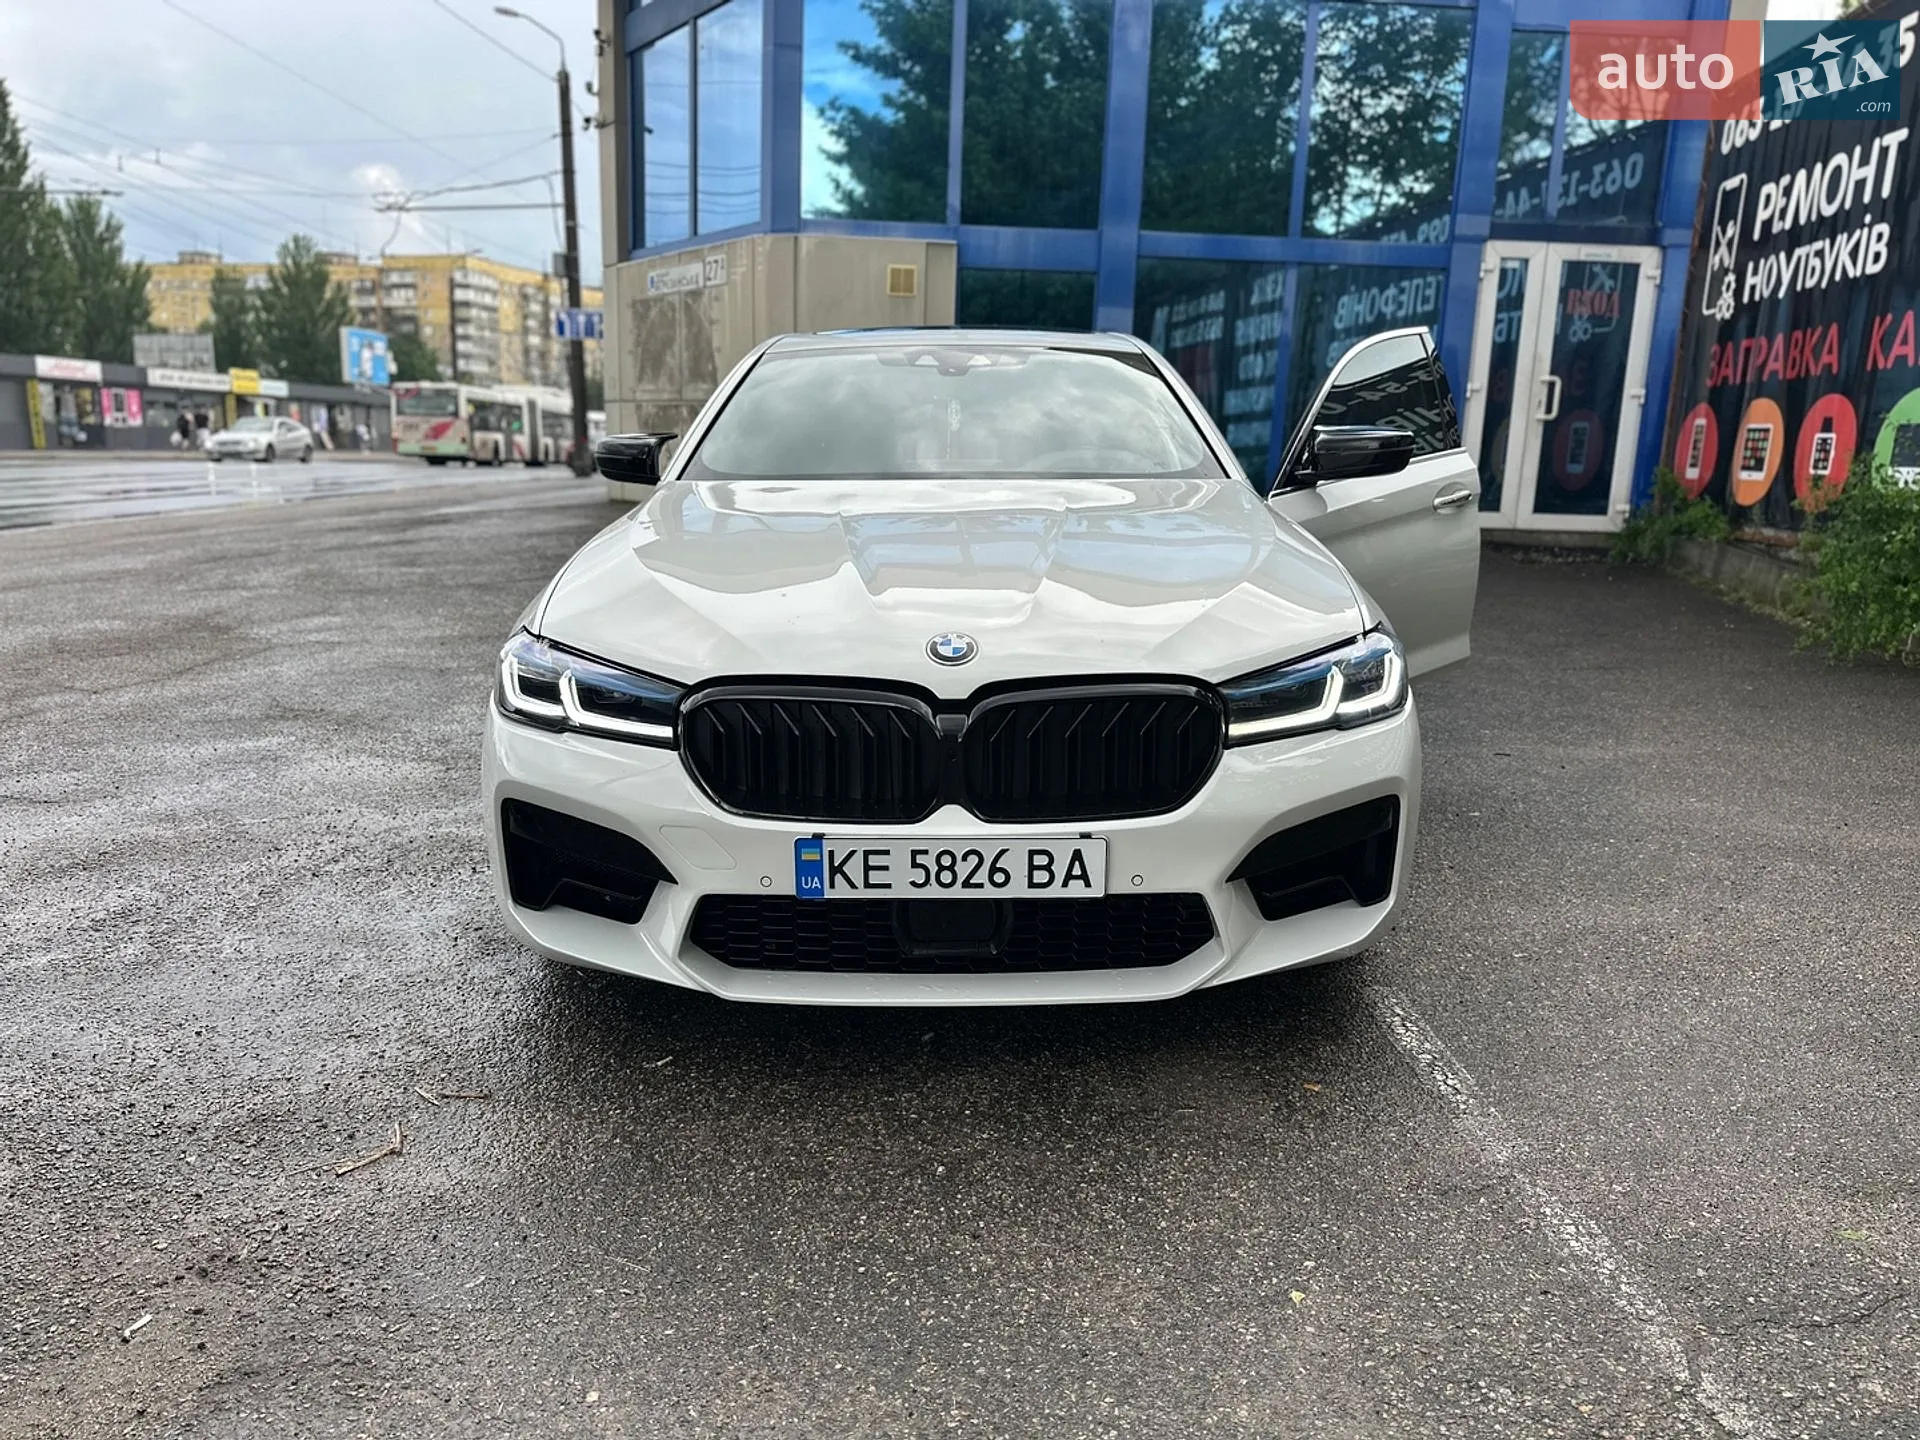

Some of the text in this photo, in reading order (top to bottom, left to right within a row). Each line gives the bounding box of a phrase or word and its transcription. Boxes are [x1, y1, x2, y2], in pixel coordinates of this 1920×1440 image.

[1752, 126, 1909, 242] РЕМОНТ
[1705, 321, 1839, 388] ЗАПРАВКА
[1866, 309, 1920, 372] КА
[802, 876, 821, 888] UA
[827, 848, 1092, 890] KE 5826 BA
